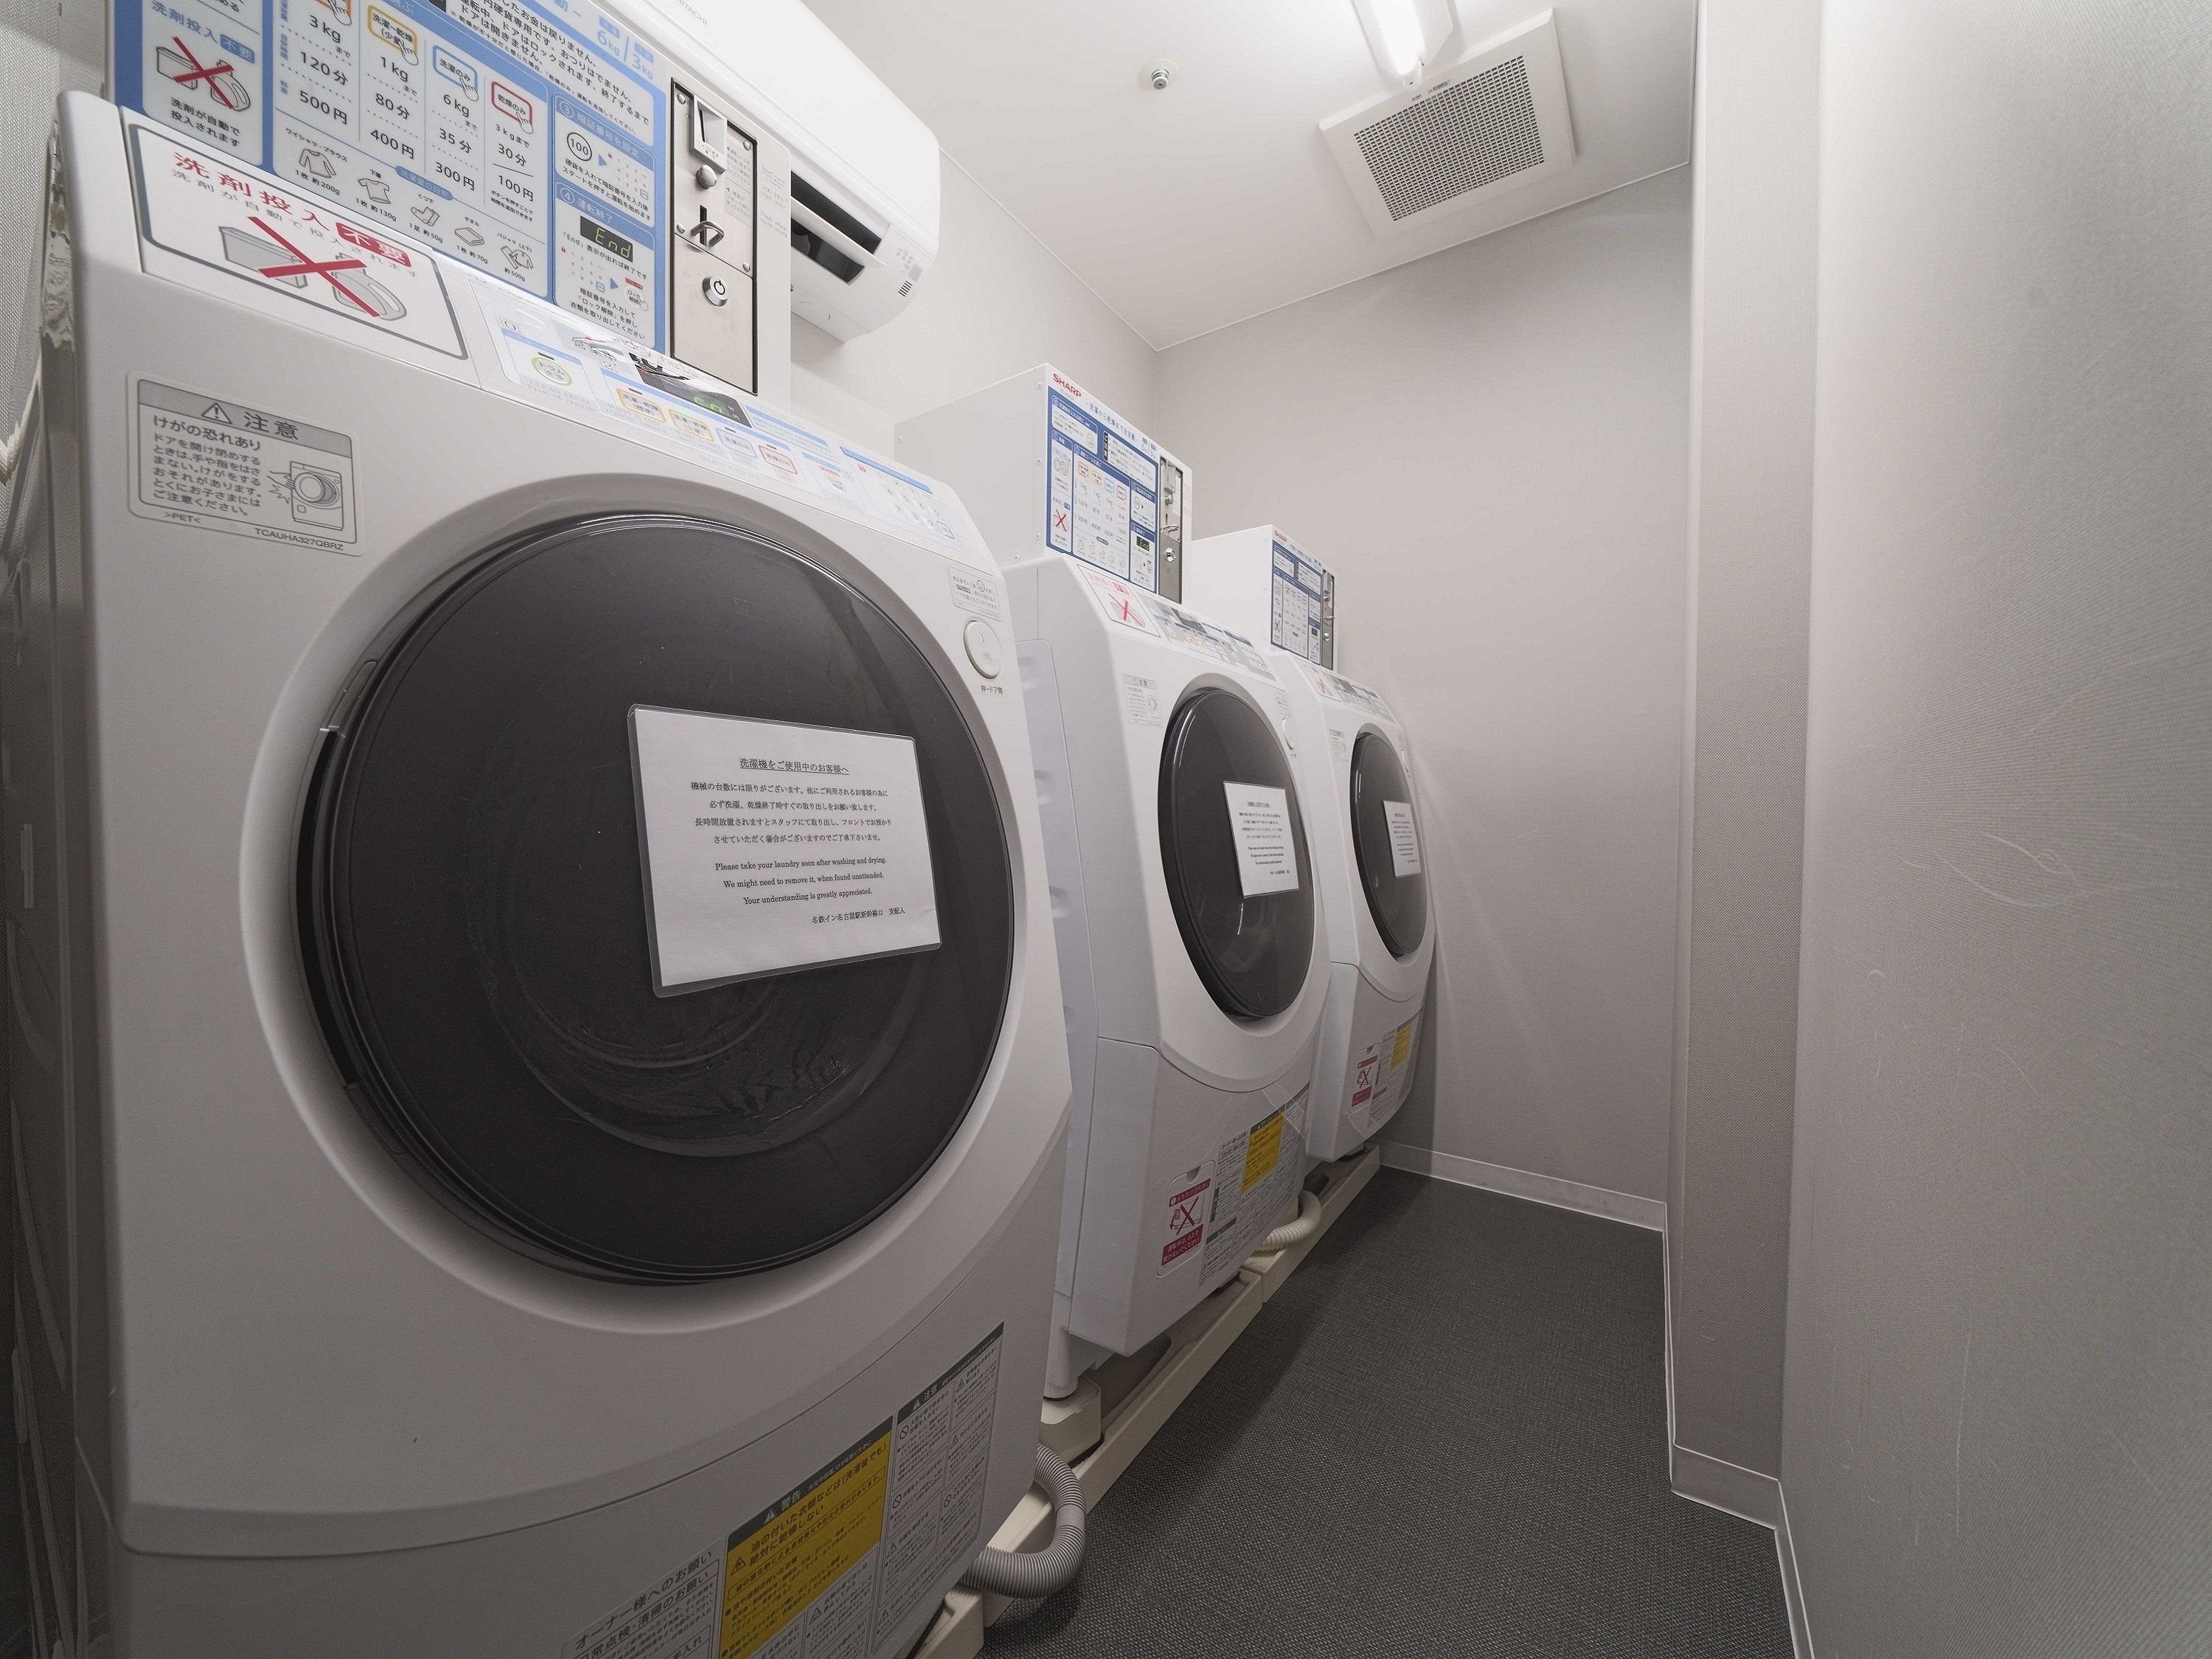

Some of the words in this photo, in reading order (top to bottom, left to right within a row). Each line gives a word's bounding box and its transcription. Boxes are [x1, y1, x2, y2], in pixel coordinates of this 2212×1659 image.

[151, 1, 218, 44] 洗剤投入
[462, 4, 543, 65] ドアは開きません。
[301, 50, 348, 86] 120分
[439, 58, 471, 83] 洗濯のみ
[170, 97, 240, 136] 洗剤が自動で
[300, 90, 348, 125] 500円
[375, 93, 411, 120] 80分
[498, 94, 526, 116] 乾燥のみ
[170, 111, 240, 147] 投入されます
[439, 127, 473, 155] 35分
[577, 113, 640, 159] 暗証番号を設定
[370, 129, 414, 160] 400円
[498, 143, 527, 167] 30分
[571, 138, 589, 156] 100
[435, 161, 475, 191] 300円
[498, 175, 533, 202] 100円
[173, 152, 330, 231] 洗剤投入
[343, 227, 405, 261] 不要
[578, 198, 613, 223] 運転終了
[595, 226, 632, 259] End
[1053, 373, 1082, 397] SHARP
[153, 415, 260, 451] けがの恐れあり
[243, 411, 298, 440] 注意
[154, 433, 260, 465] ドアを開け閉めする
[154, 445, 260, 476] ときは、手や指をはさ
[153, 456, 260, 486] まない。けがをする
[153, 467, 262, 498] おそれがあります。
[153, 479, 261, 507] とくにお子さまには
[154, 490, 248, 516] ご注意ください。
[740, 758, 849, 773] 洗濯機をご使用中のお客様へ
[715, 863, 739, 871] Please
[740, 861, 757, 869] take
[757, 862, 773, 870] your
[775, 860, 800, 869] laundry
[832, 858, 855, 866] washing
[868, 857, 887, 865] drying.
[723, 880, 735, 888] We
[737, 880, 758, 888] might
[759, 878, 776, 886] need
[852, 872, 884, 880] unattended.
[743, 897, 760, 905] Your
[762, 892, 809, 903] understanding
[816, 891, 838, 900] greatly
[838, 888, 873, 897] appreciated.
[812, 909, 883, 924] 名鉄イン名古屋駅新幹線口
[888, 907, 905, 916] 支配人
[782, 1490, 801, 1512] 警告
[749, 1504, 824, 1567] 絶対に乾燥しない
[575, 1551, 712, 1650] オーナー様へのお願い
